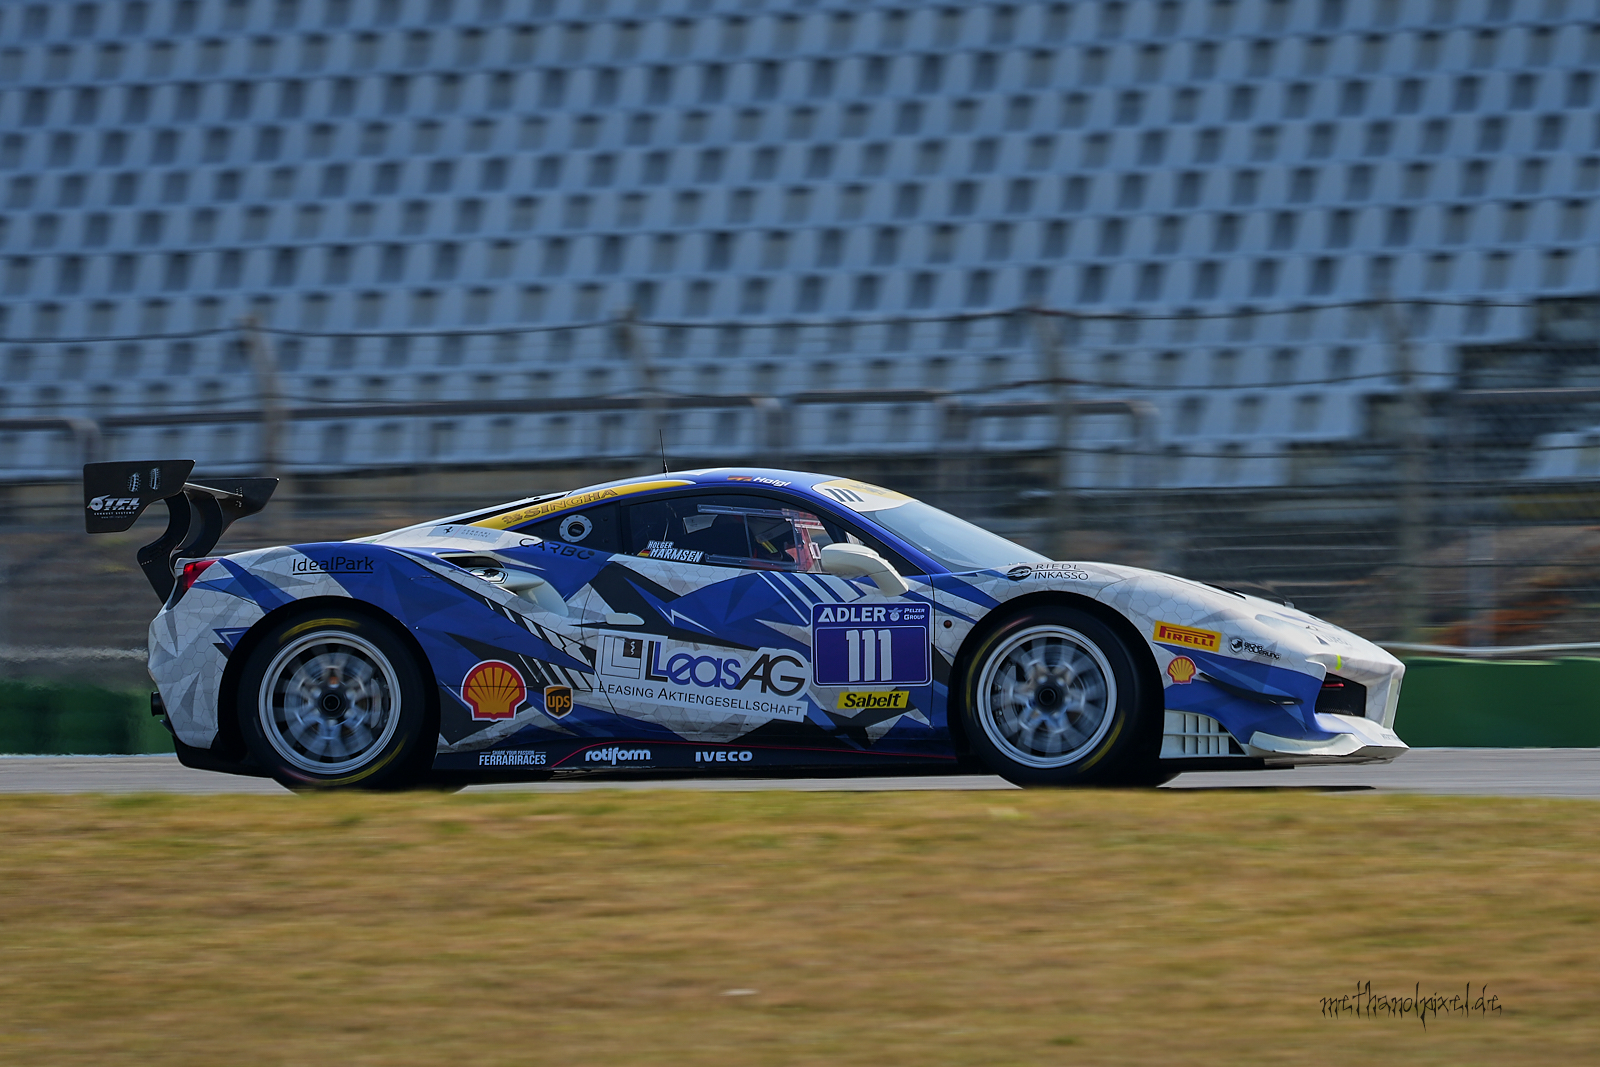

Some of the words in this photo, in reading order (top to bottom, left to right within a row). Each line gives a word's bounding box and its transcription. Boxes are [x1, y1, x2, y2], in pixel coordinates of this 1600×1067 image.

[104, 497, 140, 506] TFL
[825, 488, 865, 503] 111
[524, 488, 618, 519] SINGHA
[648, 541, 674, 549] HOLGER
[649, 548, 703, 562] HARMSEN
[292, 556, 374, 572] IdealPark
[1034, 571, 1089, 581] INKASSO
[817, 607, 887, 623] ADLER
[1159, 625, 1216, 647] PIRELLI
[846, 629, 892, 682] 111
[547, 695, 571, 713] ups
[599, 680, 654, 699] LEASING
[657, 687, 802, 717] AKTIENGESELLSCHAFT
[844, 693, 901, 708] Sabelt
[479, 754, 547, 766] FERRARIRACES
[584, 747, 652, 766] rotiform
[695, 751, 754, 763] IVECO
